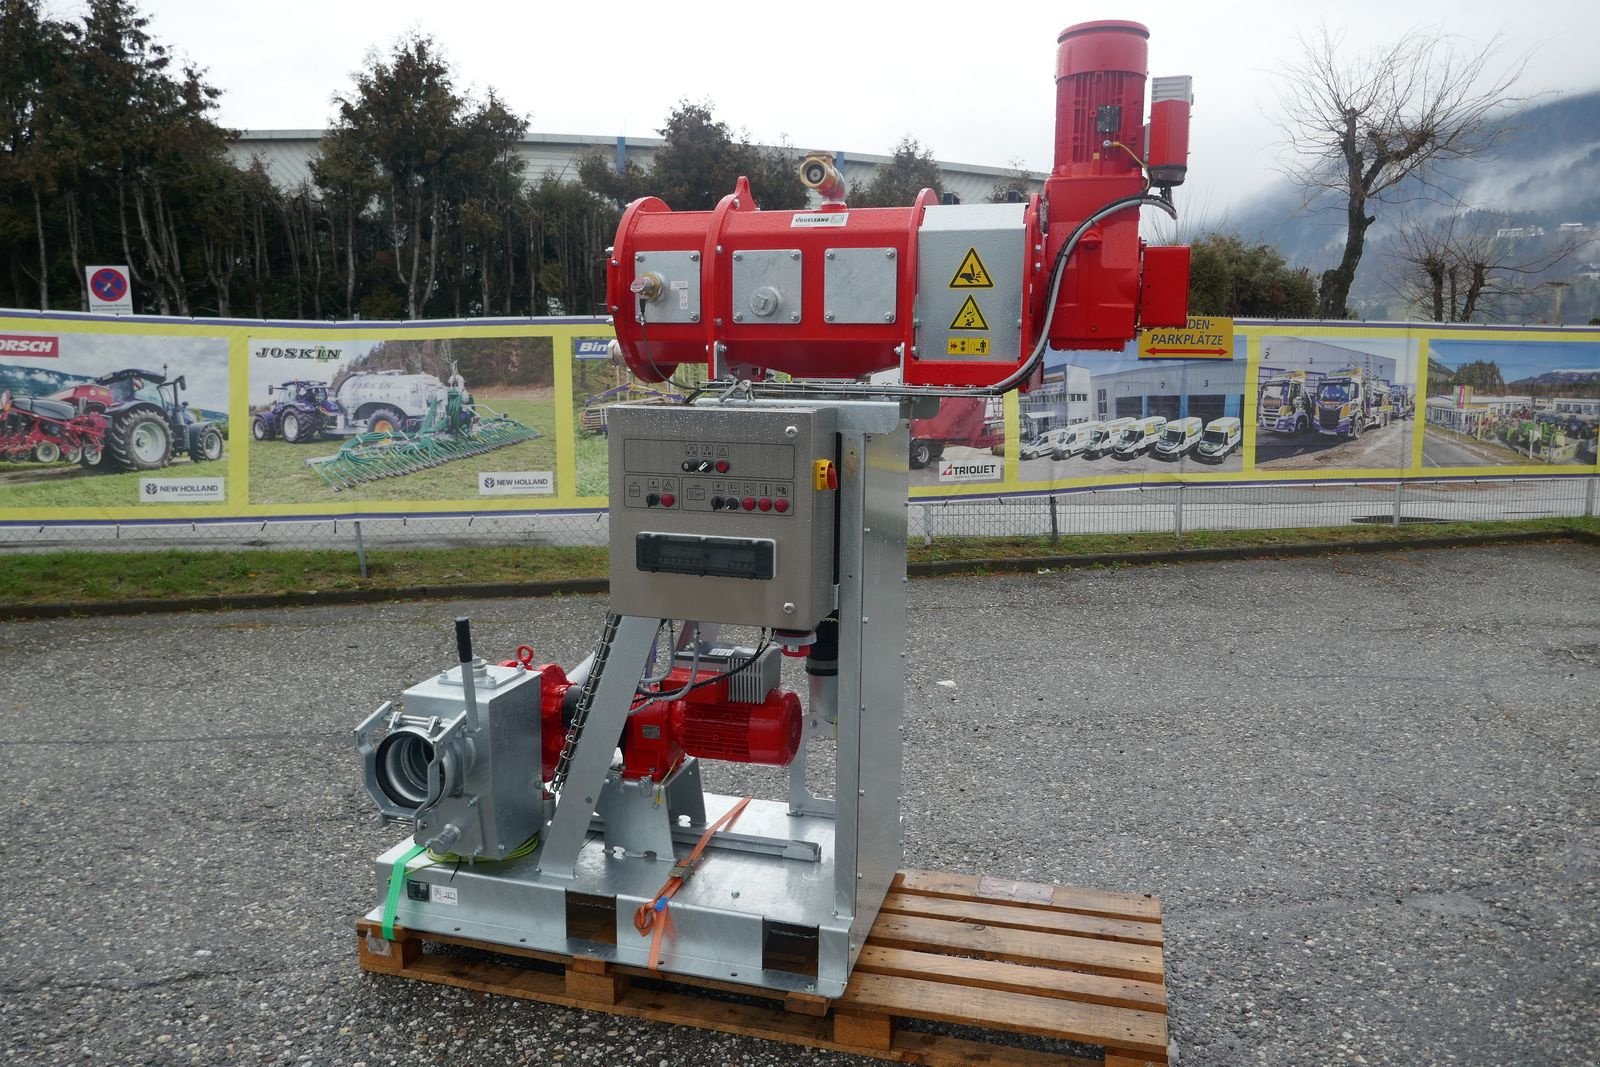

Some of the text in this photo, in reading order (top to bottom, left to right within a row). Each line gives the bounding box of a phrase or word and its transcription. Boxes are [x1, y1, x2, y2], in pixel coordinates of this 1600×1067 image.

[1150, 330, 1224, 346] PARKPLÄTZE
[255, 346, 342, 361] JOSKIN
[952, 464, 996, 475] TRIOLIET
[514, 478, 548, 486] HOLLAND
[160, 484, 218, 493] NEW HOLLAND
